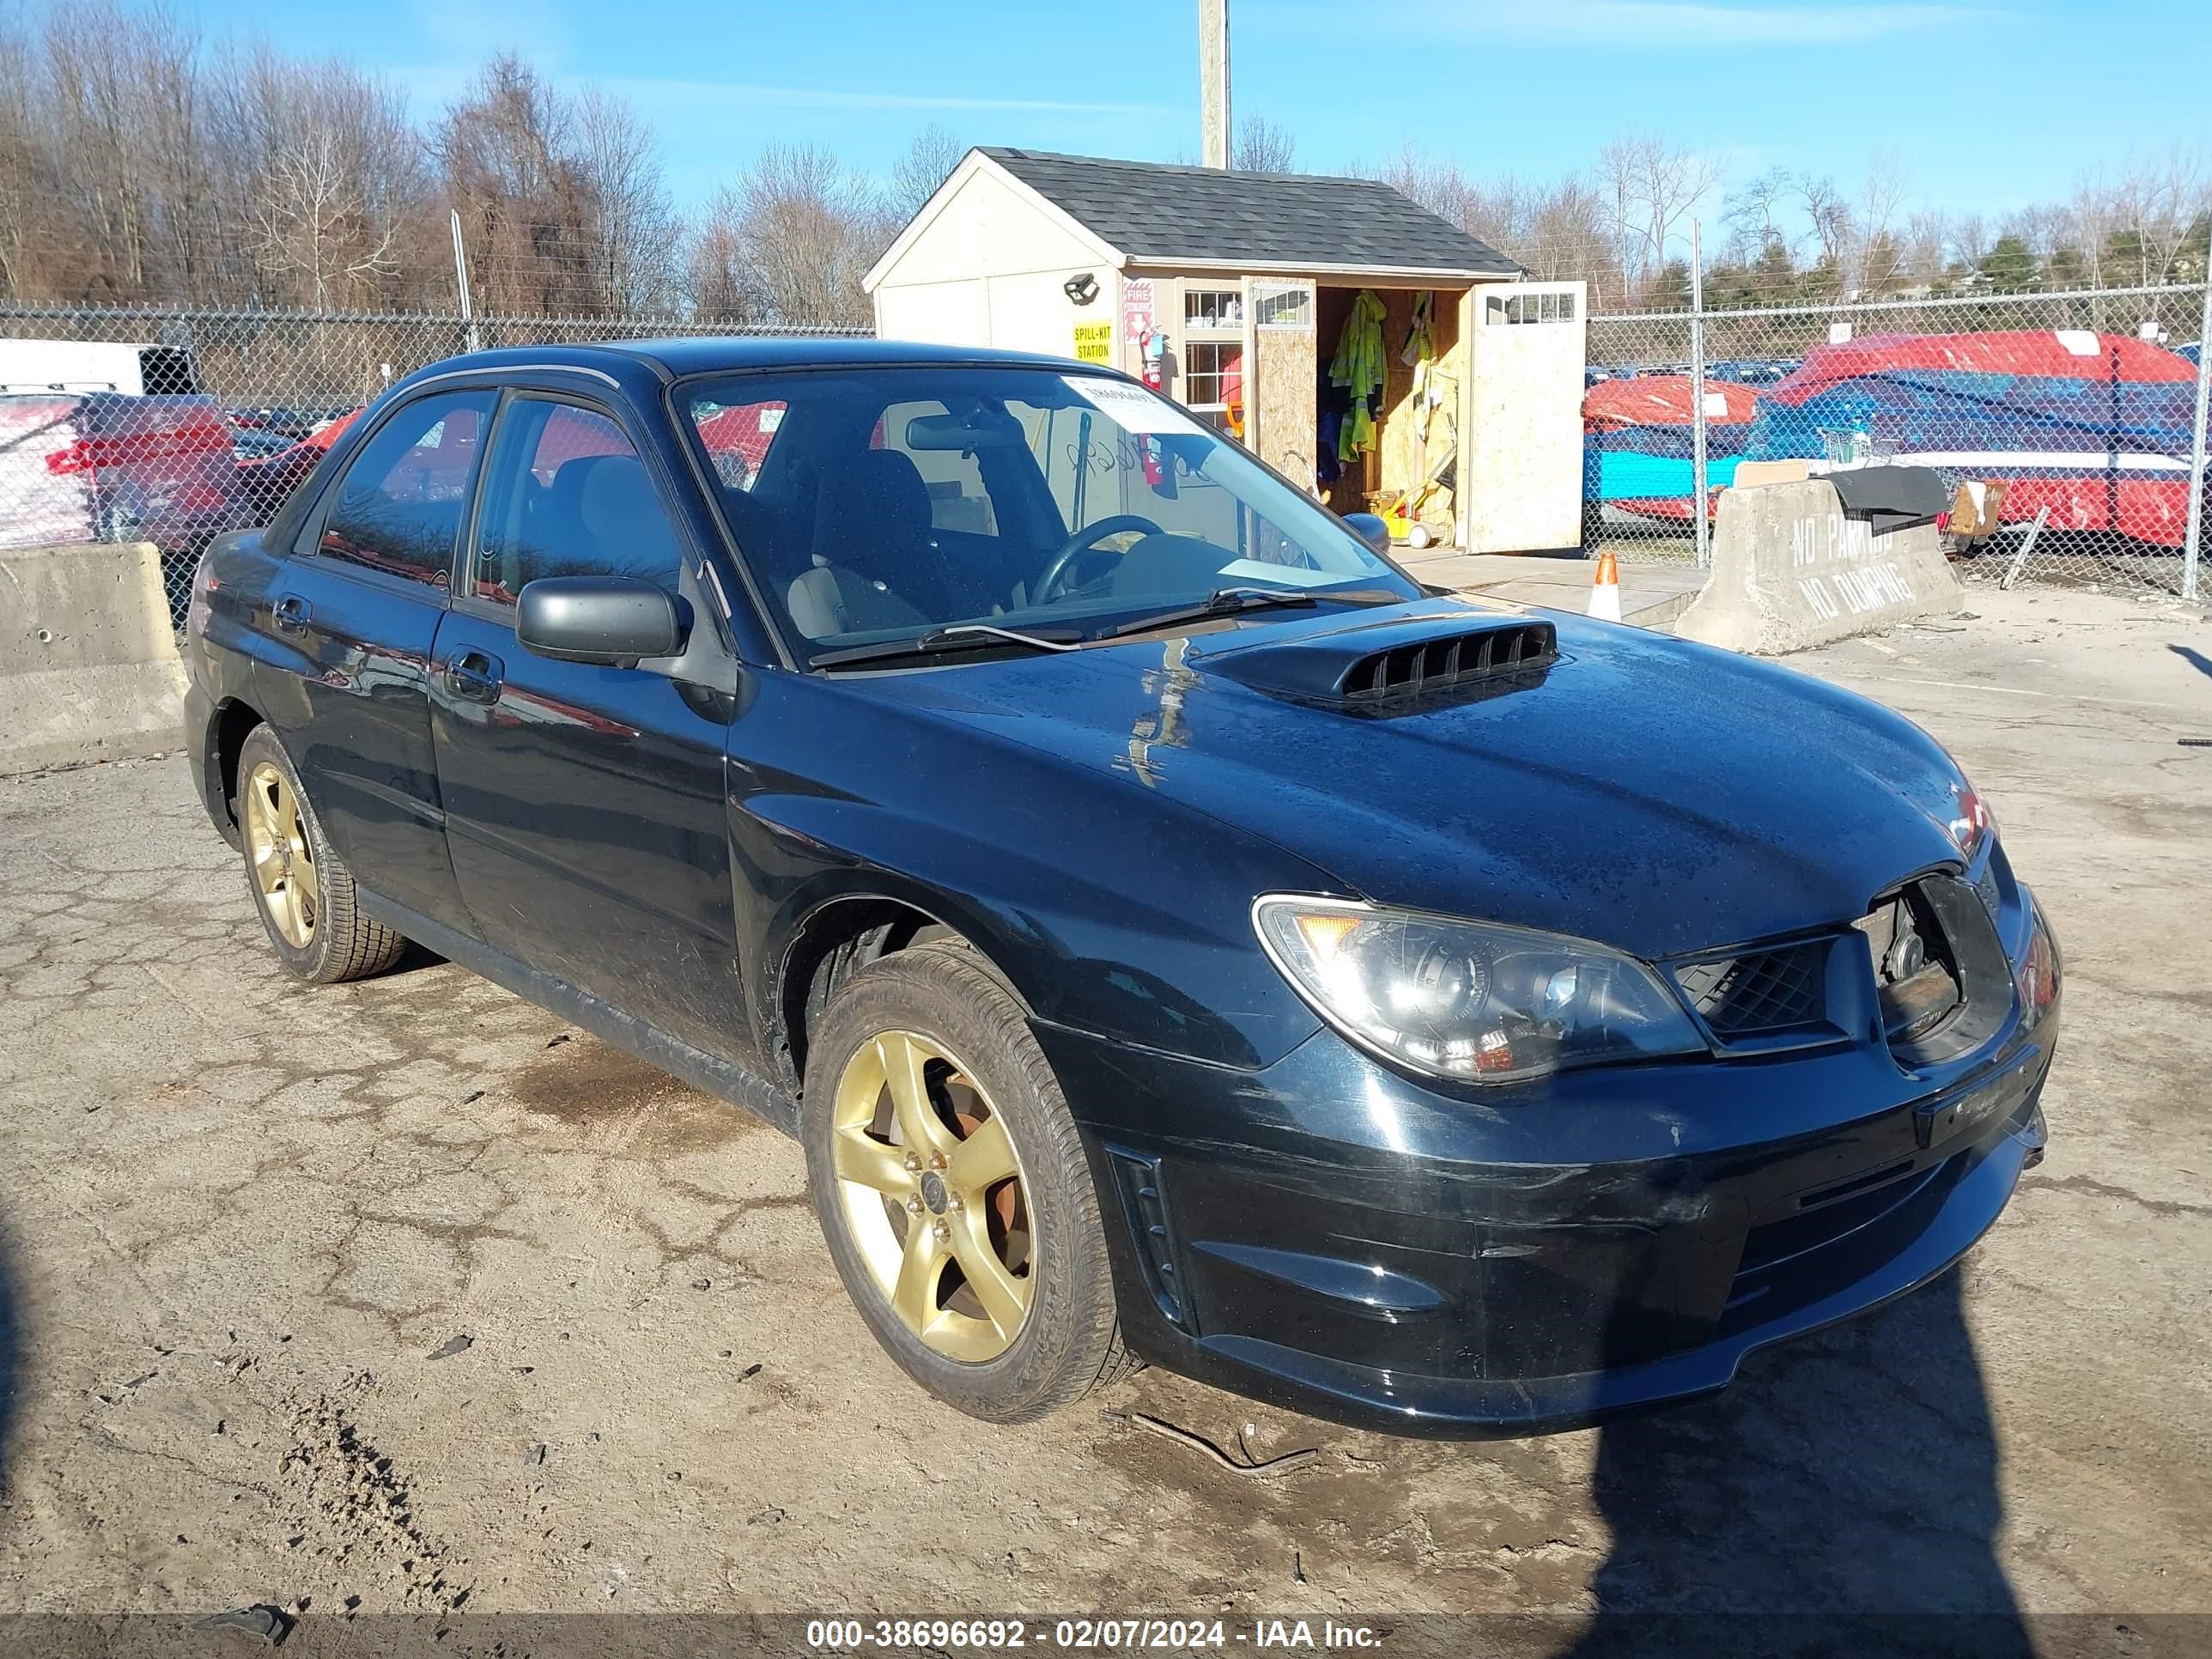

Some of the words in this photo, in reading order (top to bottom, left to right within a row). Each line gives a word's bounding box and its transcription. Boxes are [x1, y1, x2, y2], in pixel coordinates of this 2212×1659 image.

[1127, 290, 1150, 301] FIRE
[1074, 326, 1111, 342] SPILL-KIT
[1078, 345, 1109, 359] STATION
[1793, 518, 1816, 567] NO
[1797, 577, 1839, 620] NO
[1832, 562, 1915, 615] DUMPING
